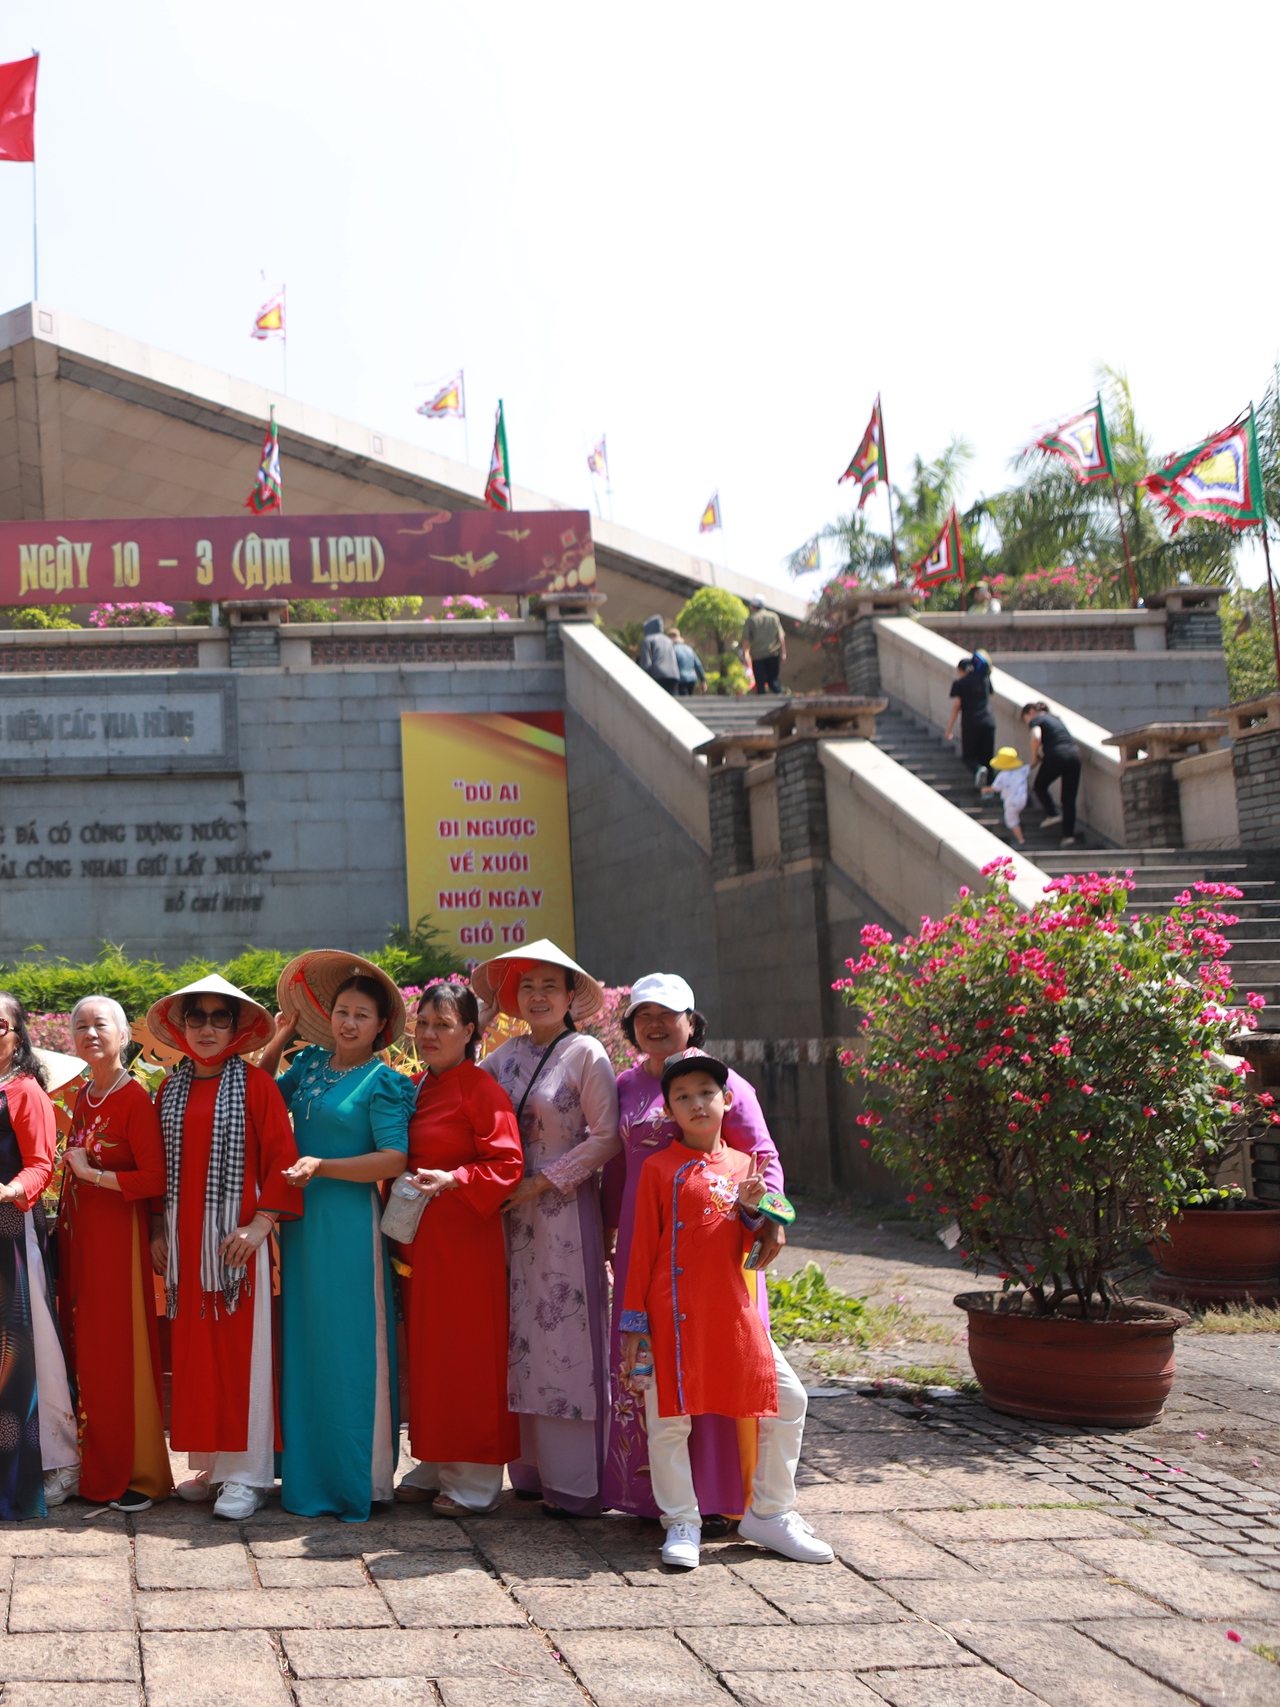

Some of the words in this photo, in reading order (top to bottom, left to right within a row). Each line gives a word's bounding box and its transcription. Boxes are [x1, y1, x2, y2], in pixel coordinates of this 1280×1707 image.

[18, 536, 92, 597] NGÀY
[111, 540, 141, 588] 10
[196, 539, 213, 586] 3
[232, 532, 292, 591] (ÂM
[311, 535, 386, 591] LỊCH)
[57, 707, 96, 739] CÁC
[101, 711, 139, 739] VUA
[143, 705, 194, 738] HÙNG
[498, 783, 520, 802] AI
[48, 821, 72, 844] CÓ
[439, 820, 460, 838] ĐI
[466, 818, 537, 841] NGƯỢC
[80, 858, 128, 877] NHAU
[449, 850, 474, 873] VỀ
[481, 852, 529, 873] XUÔI
[439, 889, 482, 909] NHỚ
[488, 887, 543, 909] NGÀY
[460, 920, 494, 944] GIỖ
[500, 919, 527, 944] TỔ
